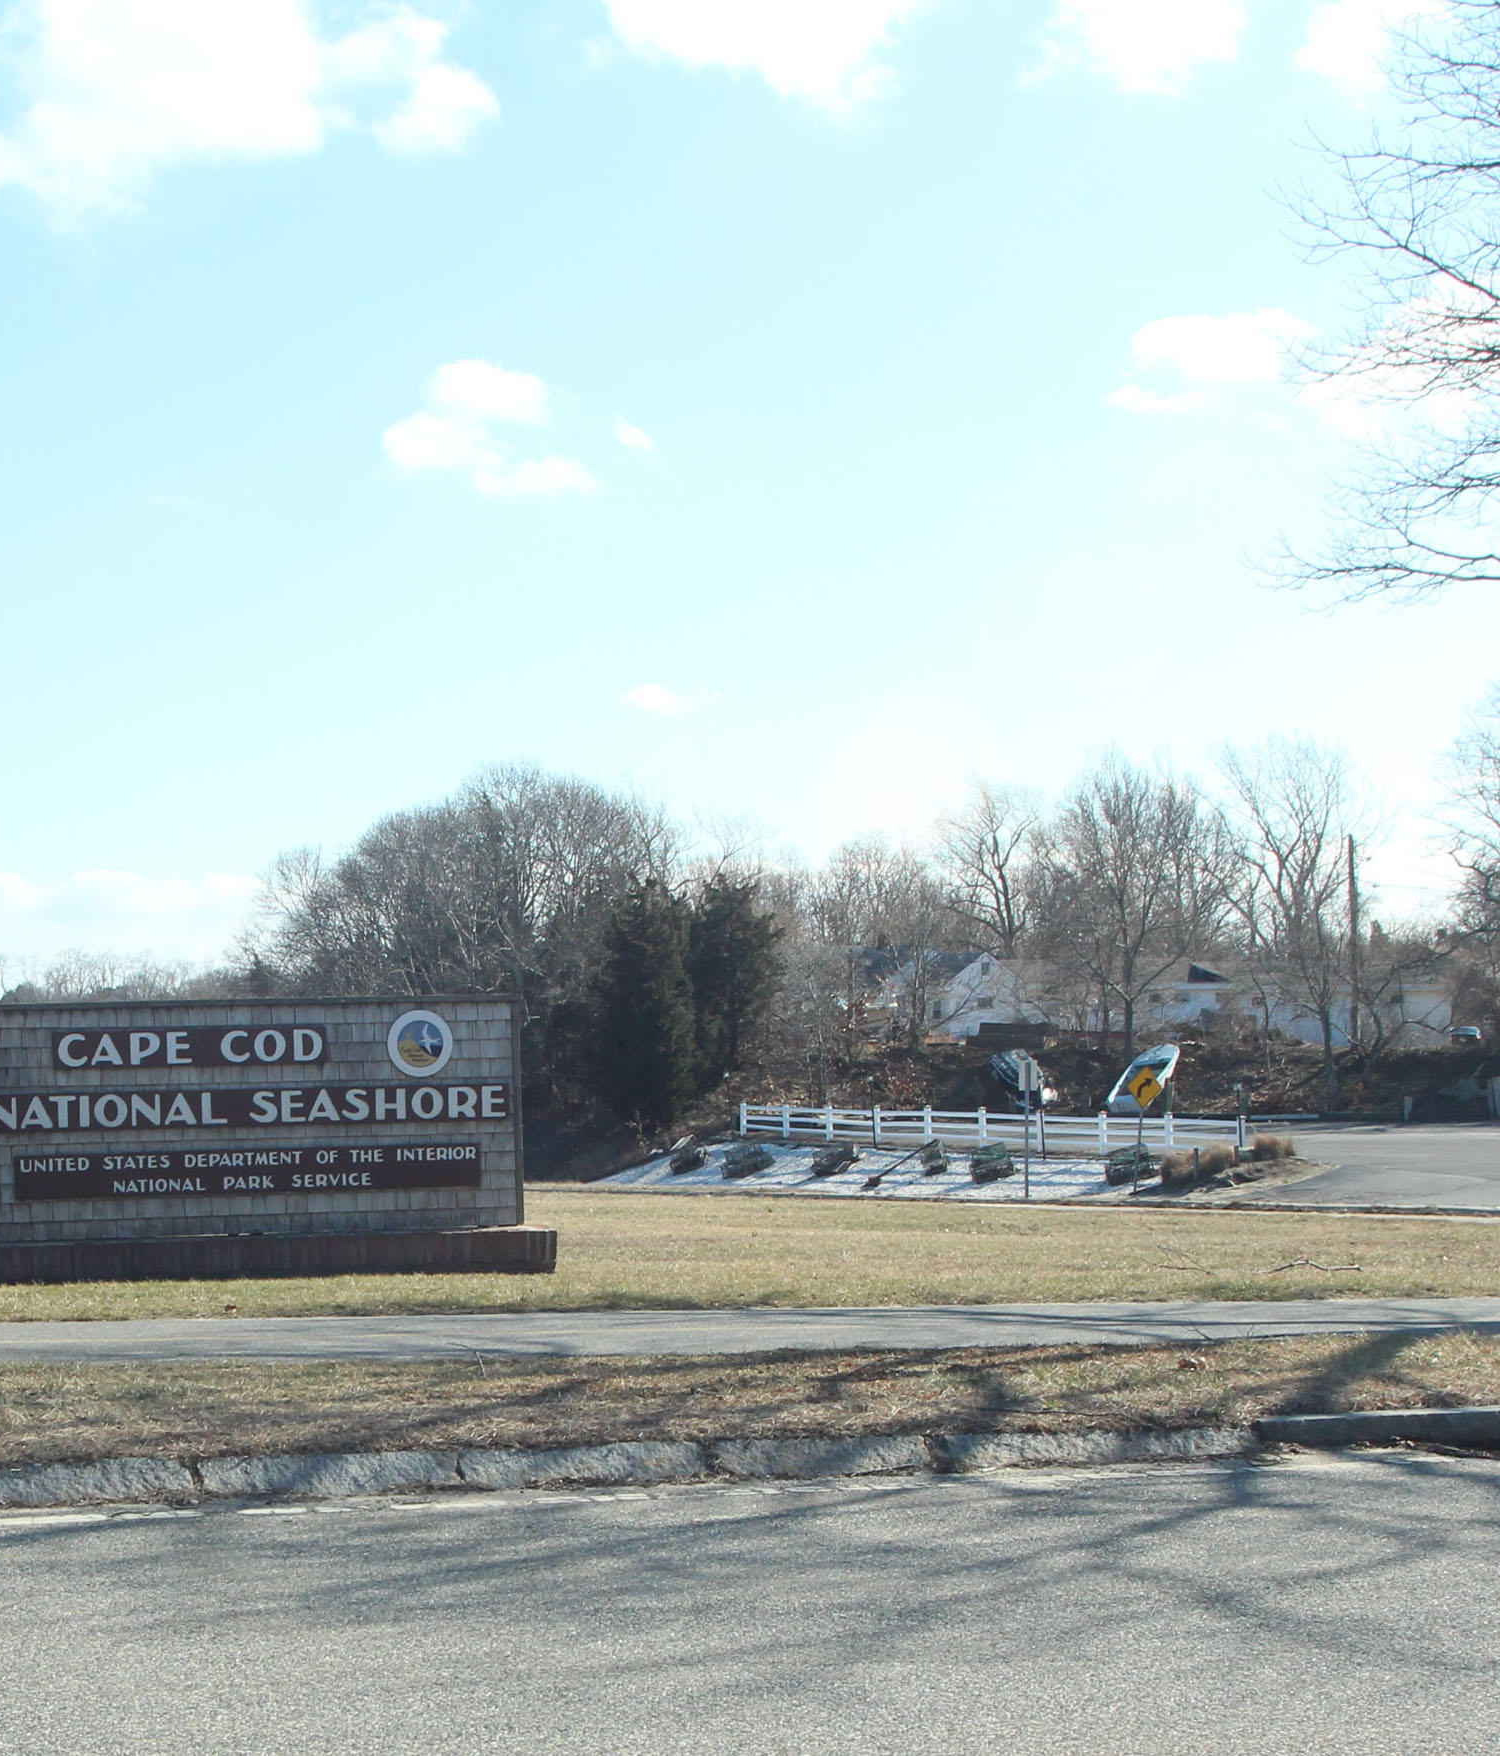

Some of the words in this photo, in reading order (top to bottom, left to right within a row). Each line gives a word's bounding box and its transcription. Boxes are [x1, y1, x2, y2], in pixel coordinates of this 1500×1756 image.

[58, 1032, 192, 1066] CAPE
[221, 1029, 322, 1062] COD
[250, 1085, 506, 1124] SEASHORE
[20, 1158, 89, 1172] UNITED
[103, 1155, 170, 1169] STATES
[185, 1151, 302, 1168] DEPARTMENT
[316, 1151, 338, 1164] OF
[351, 1149, 384, 1163] THE
[397, 1147, 476, 1161] INTERIOR
[114, 1178, 205, 1192] NATIONAL
[224, 1176, 274, 1189] PARK
[292, 1173, 371, 1188] SERVICE
